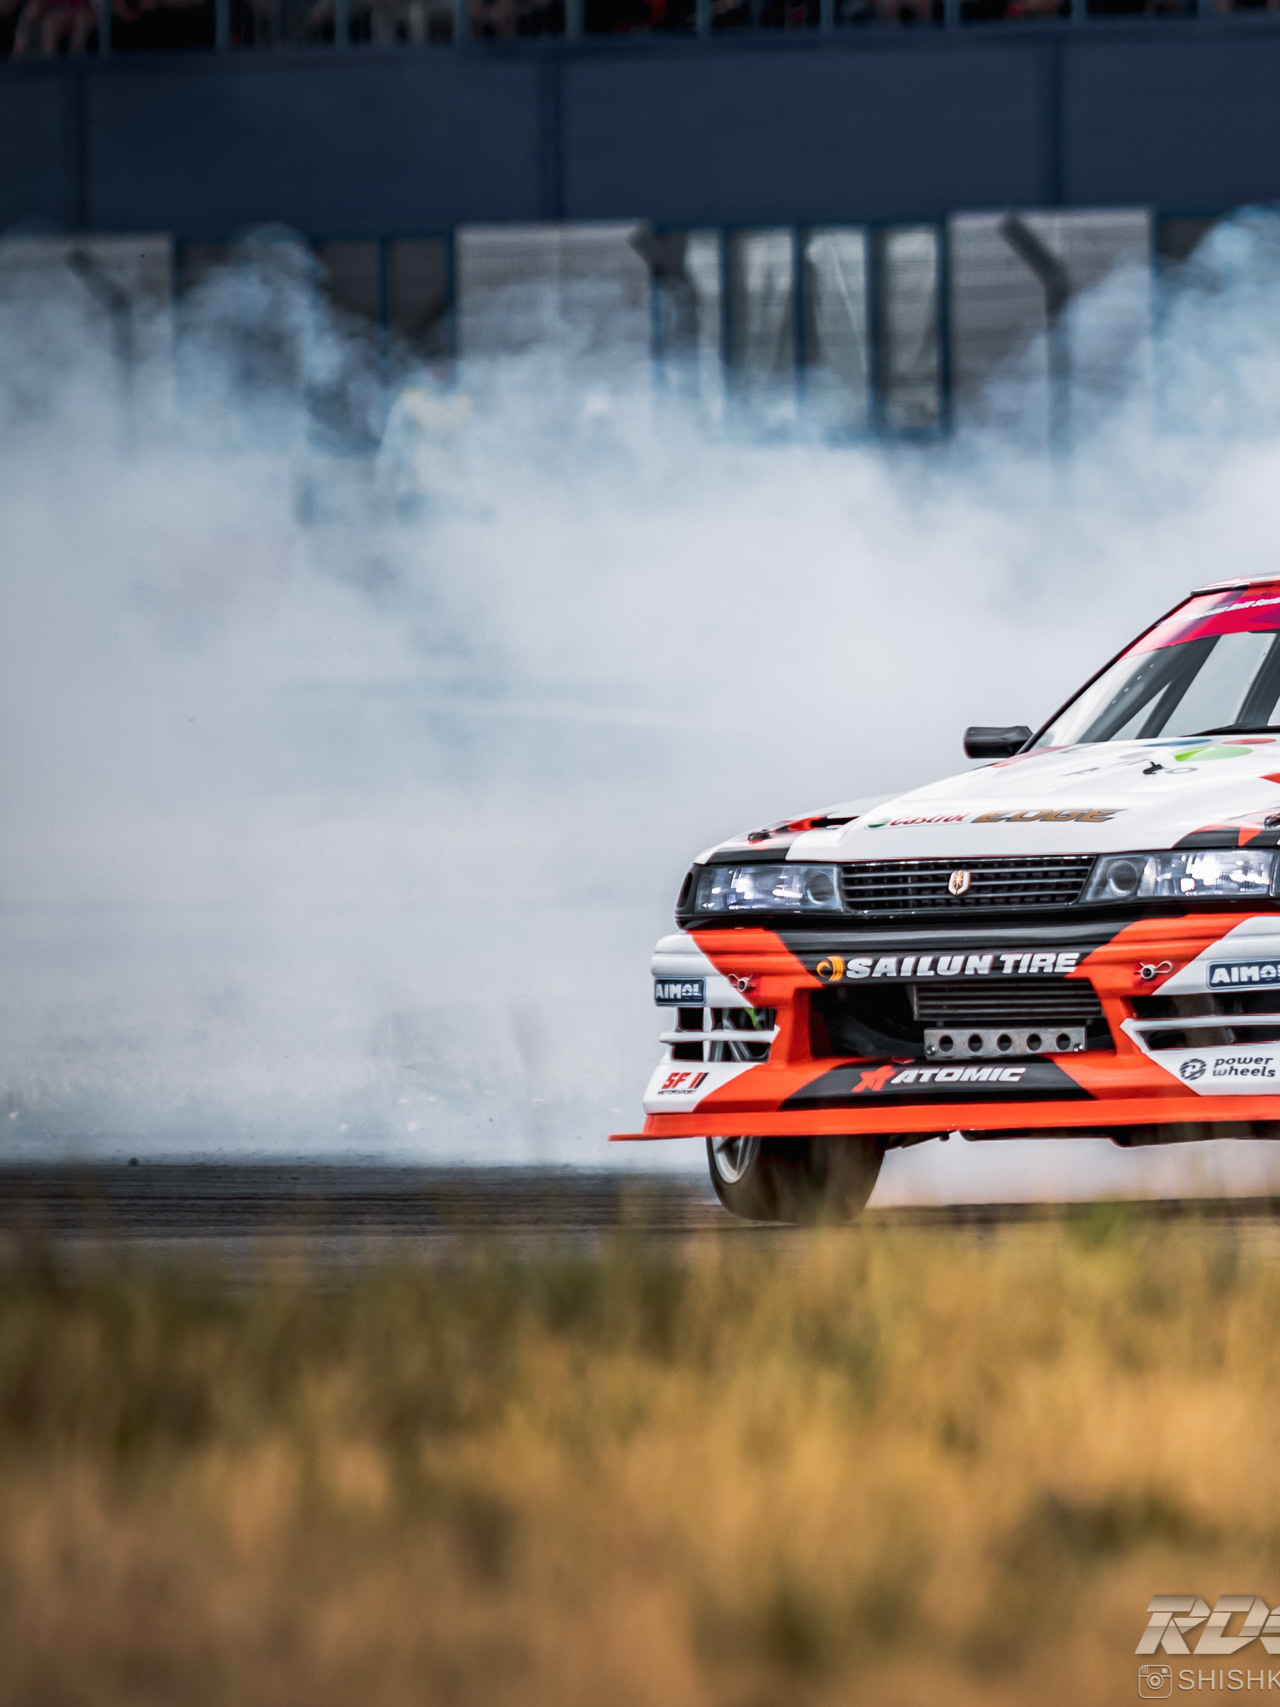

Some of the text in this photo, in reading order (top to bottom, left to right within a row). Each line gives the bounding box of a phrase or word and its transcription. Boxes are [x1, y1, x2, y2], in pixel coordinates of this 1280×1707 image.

[970, 808, 1129, 823] EDGE
[846, 952, 1081, 979] SAILUN TIRE
[655, 983, 703, 1000] AIMOL
[1213, 1056, 1274, 1068] power
[890, 1067, 1027, 1085] ATOMIC
[1212, 1064, 1276, 1078] wheels
